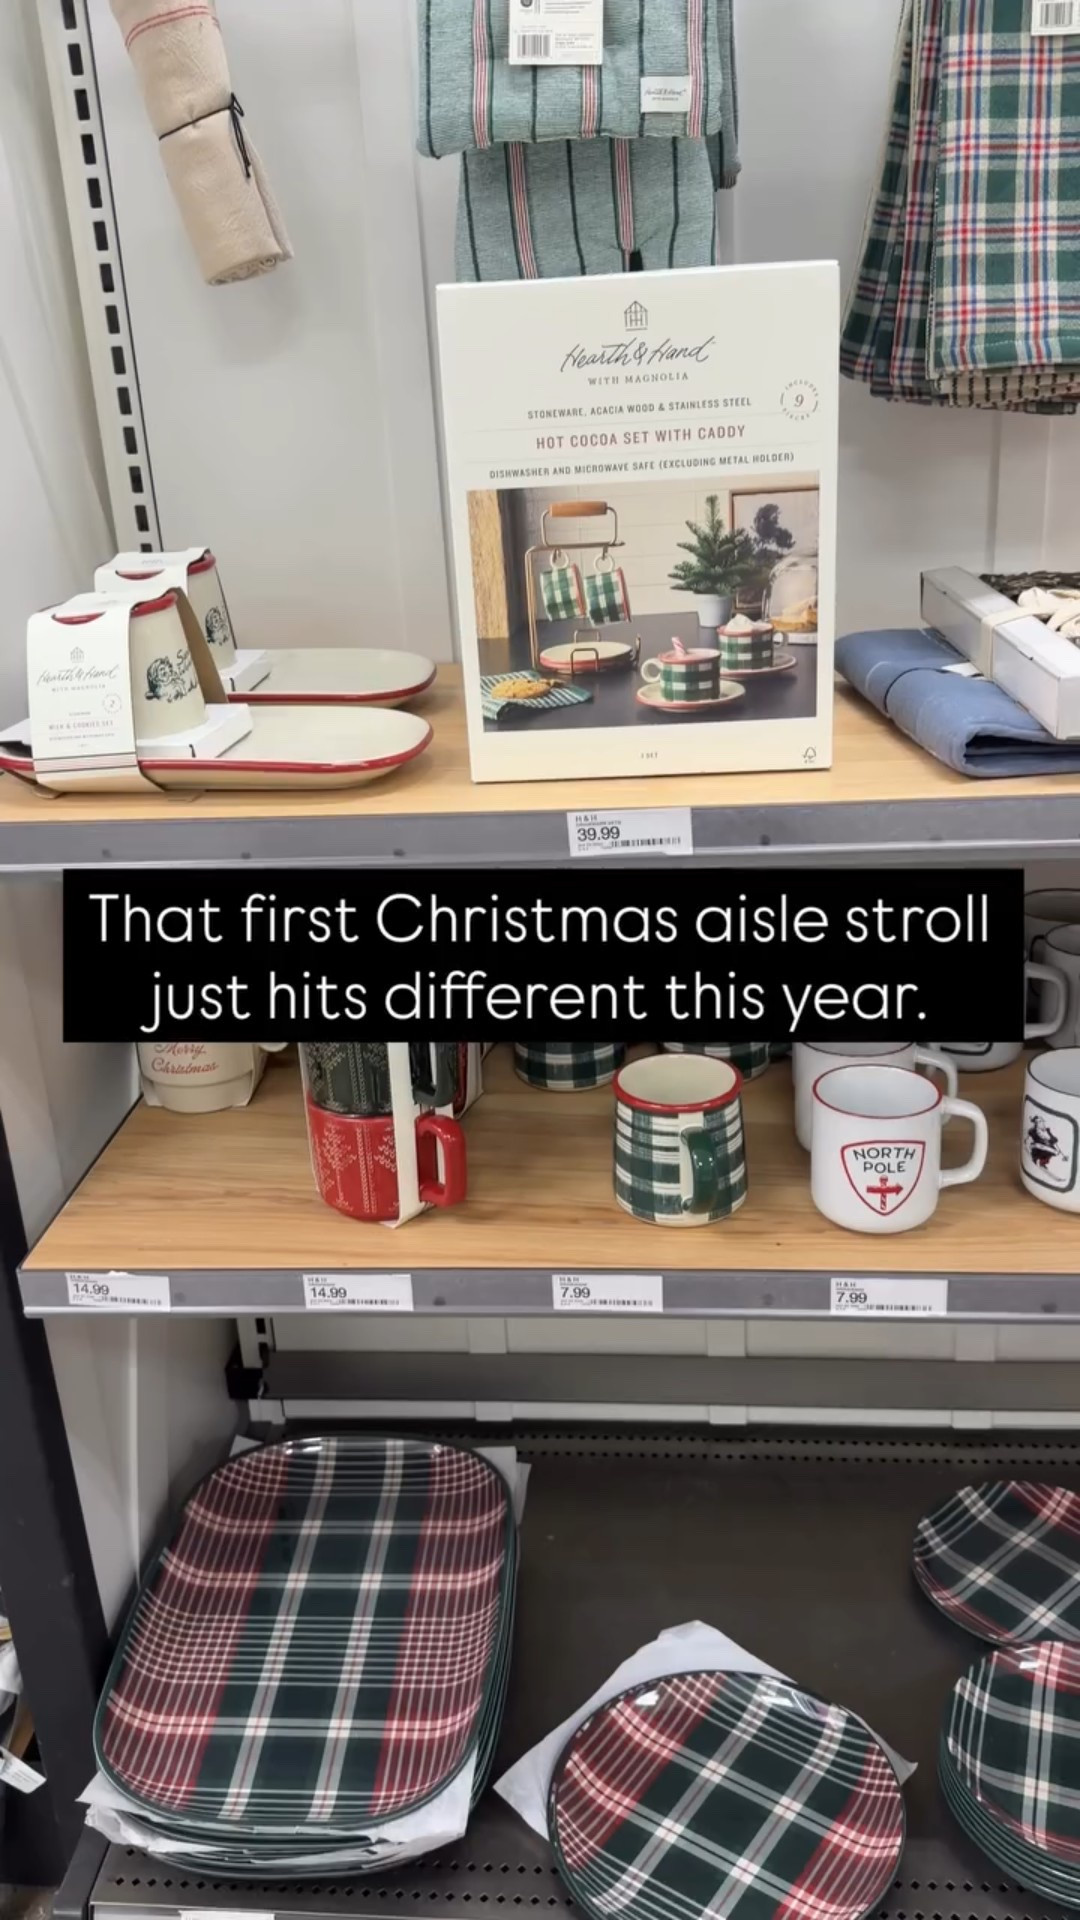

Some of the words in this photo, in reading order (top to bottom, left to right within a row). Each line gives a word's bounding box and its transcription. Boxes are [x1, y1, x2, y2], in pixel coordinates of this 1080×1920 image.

[560, 337, 637, 373] Hearth
[632, 341, 649, 366] &
[646, 335, 716, 365] Hand
[587, 376, 620, 386] WITH
[624, 371, 689, 384] MAGNOLIA
[794, 393, 805, 407] 9
[527, 407, 587, 420] STONEWARE,
[590, 405, 624, 416] ACACIA
[627, 403, 655, 414] WOOD
[658, 401, 665, 412] &
[668, 398, 720, 411] STAINLESS
[723, 397, 752, 408] STEEL
[536, 435, 564, 449] HOT
[569, 433, 618, 448] COCOA
[623, 431, 649, 445] SET
[655, 428, 692, 443] WITH
[697, 424, 746, 441] CADDY
[489, 467, 550, 479] DISHWASHER
[552, 466, 571, 475] AND
[574, 462, 630, 474] MICROWAVE
[632, 460, 655, 471] SAFE
[658, 456, 717, 470] (EXCLUDING
[719, 454, 749, 465] METAL
[752, 451, 795, 464] HOLDER)
[577, 826, 620, 842] 39.99
[151, 1057, 219, 1075] Christmas
[853, 1147, 916, 1160] NORTH
[863, 1161, 906, 1173] POLE
[74, 1283, 109, 1295] 14.99
[310, 1287, 347, 1298] 14.99
[561, 1286, 591, 1298] 7.99
[836, 1291, 868, 1303] 7.99
